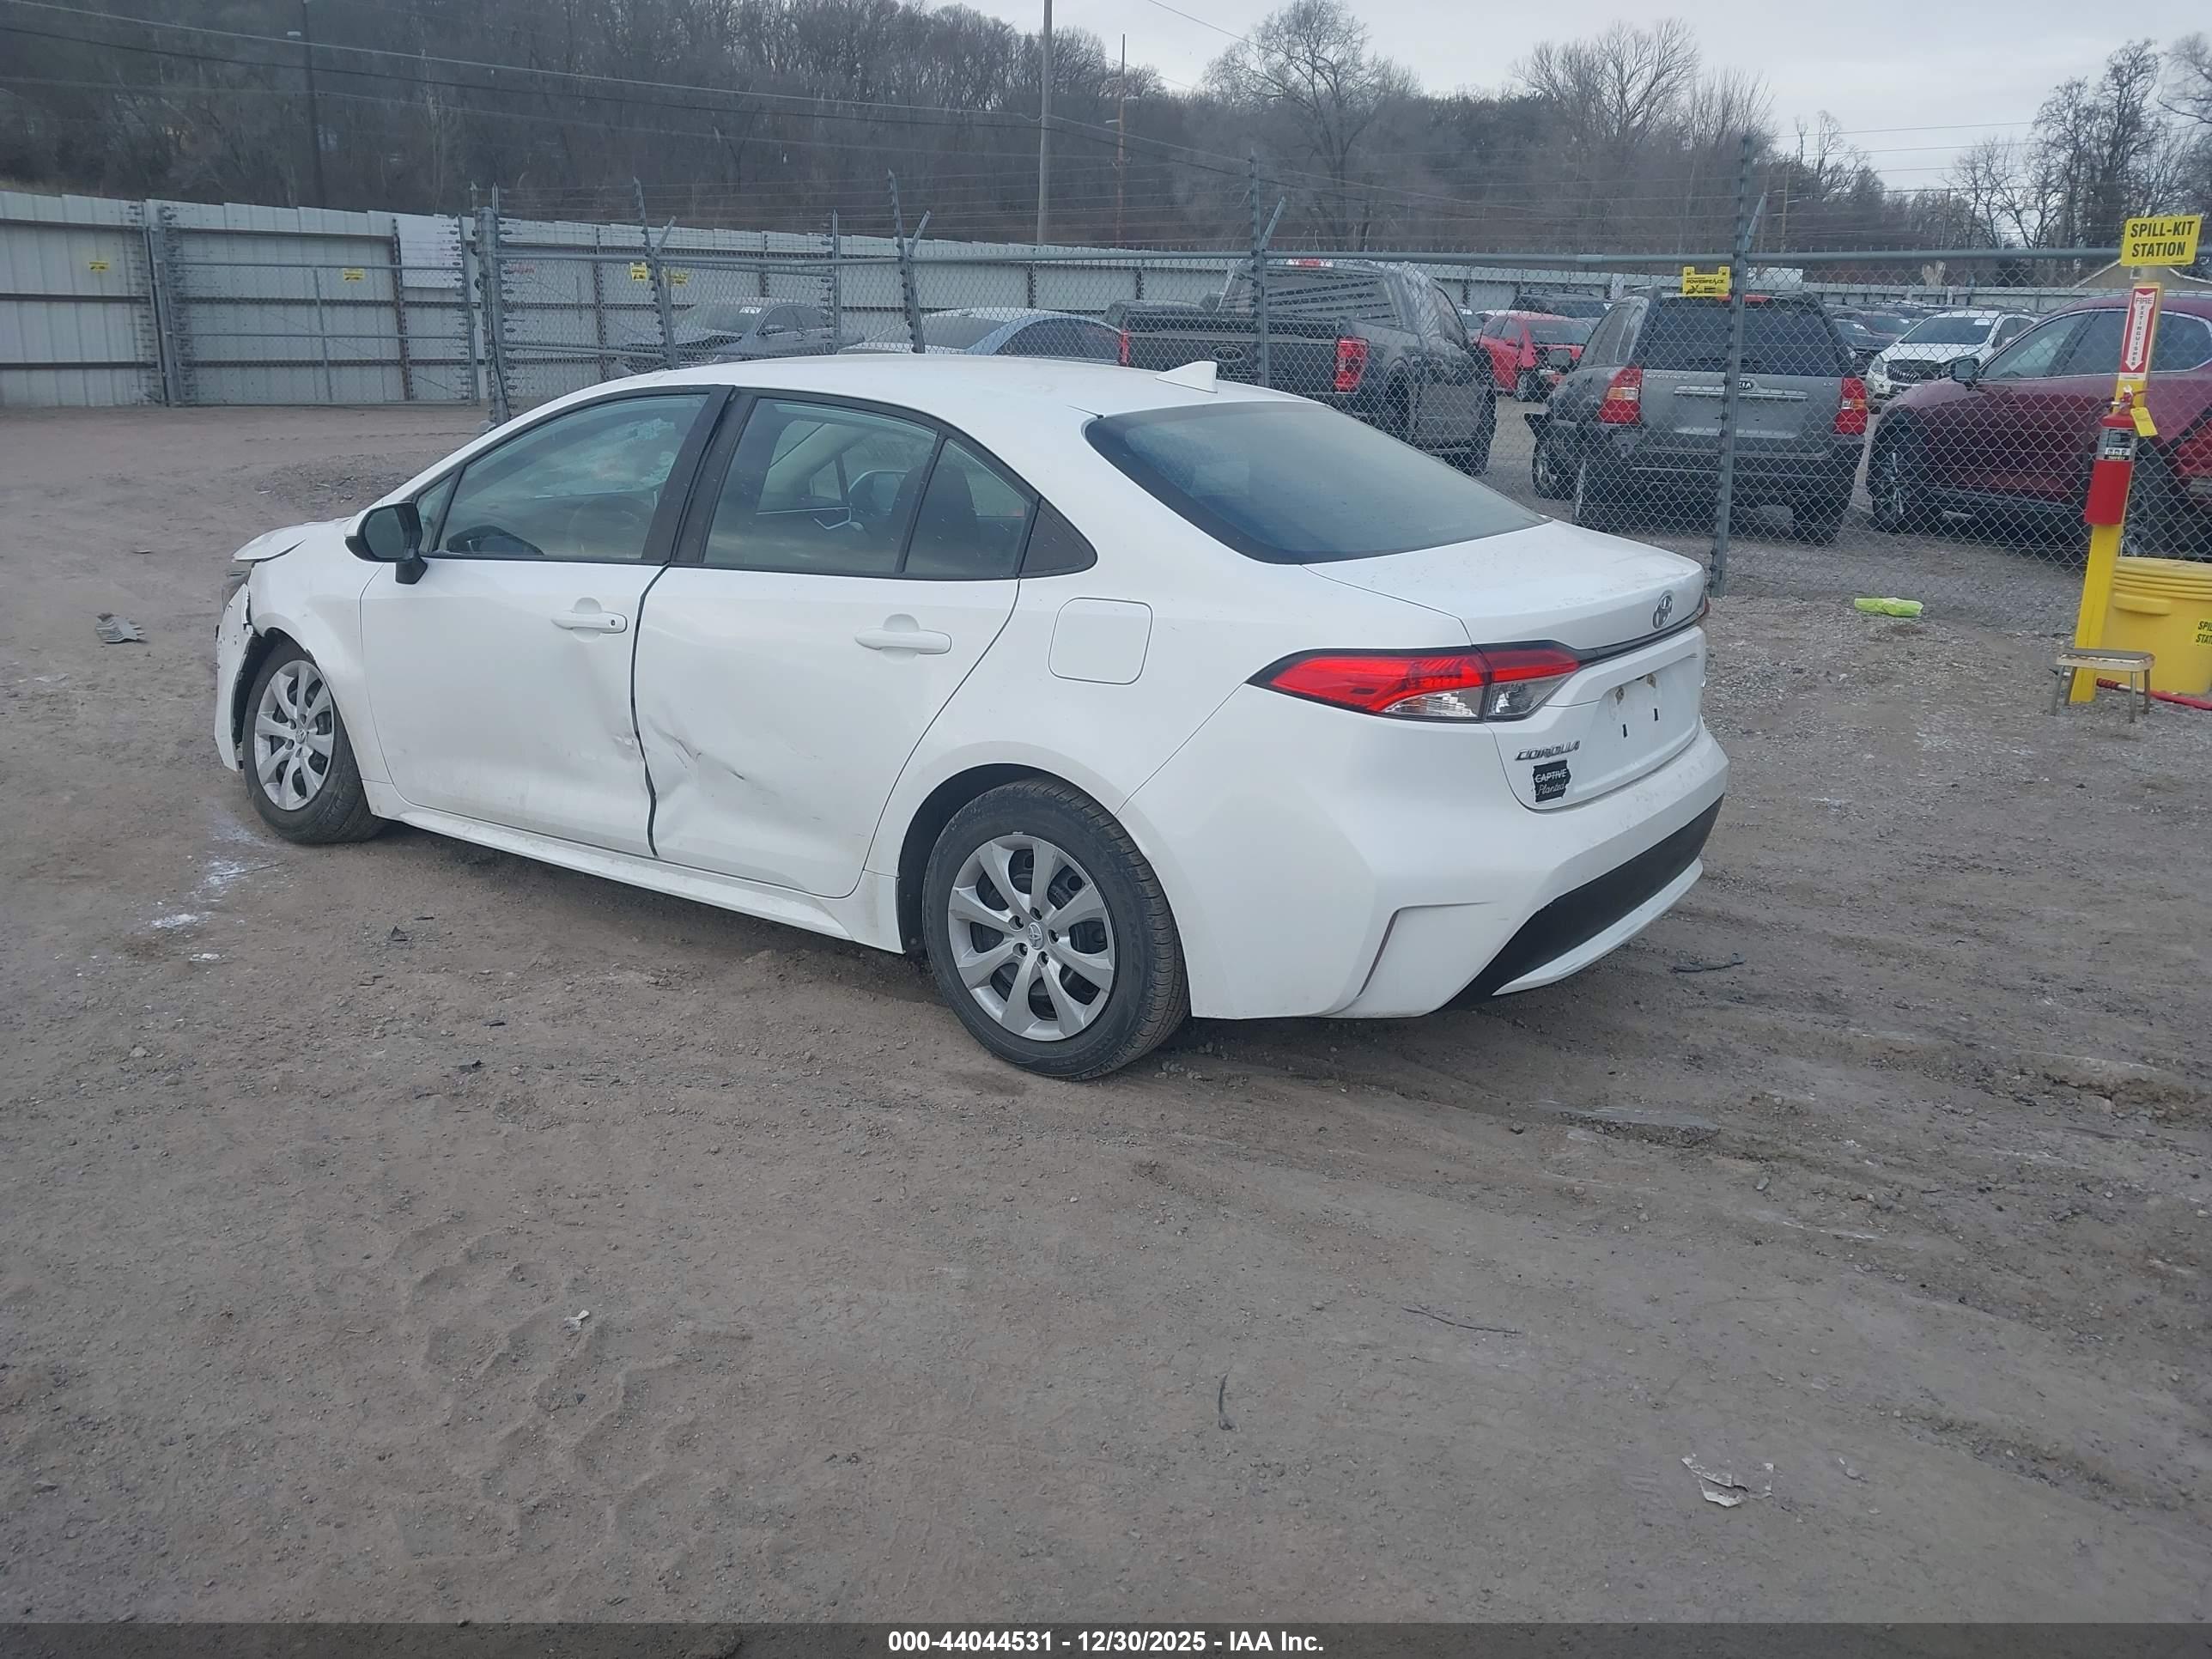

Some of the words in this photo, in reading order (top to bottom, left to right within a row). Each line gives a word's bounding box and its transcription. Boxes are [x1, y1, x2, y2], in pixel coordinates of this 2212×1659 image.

[2130, 221, 2195, 238] SPILL-KIT
[2131, 241, 2186, 257] STATION
[2130, 305, 2144, 366] EXTINGUISHER
[1516, 740, 1580, 761] COROLLA
[1535, 769, 1567, 783] CAPTIVE
[1536, 779, 1566, 796] Planted
